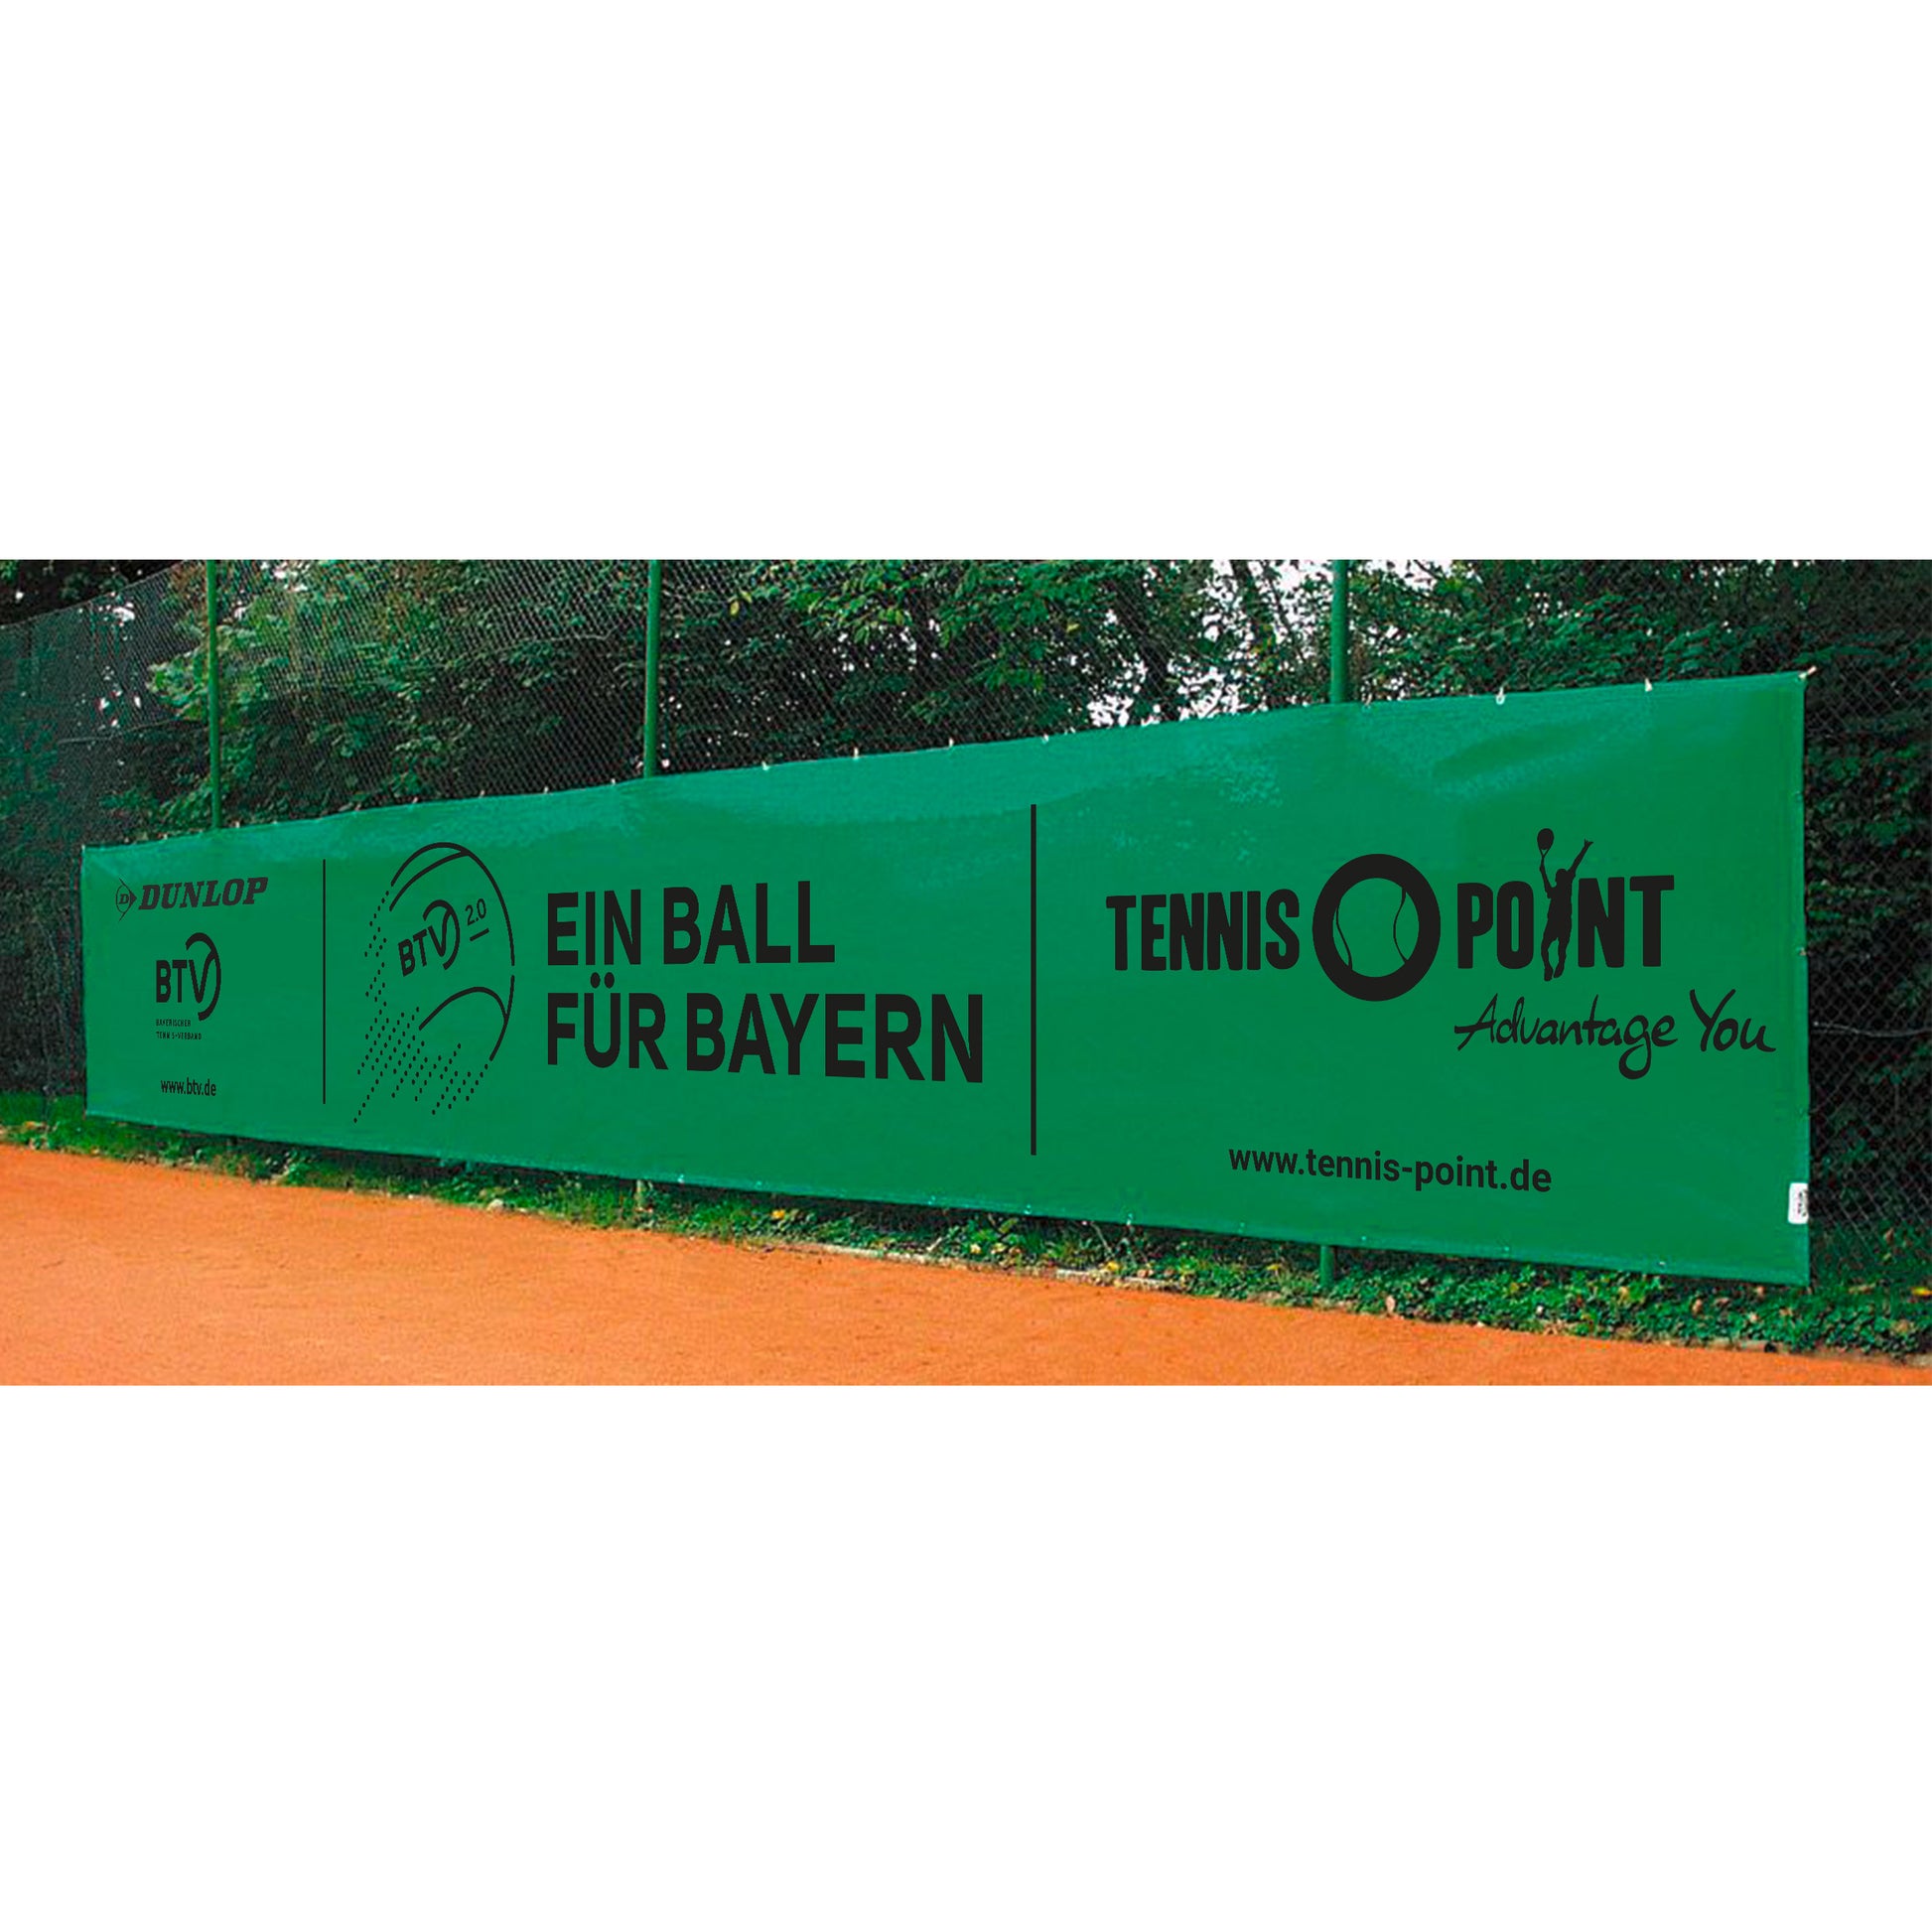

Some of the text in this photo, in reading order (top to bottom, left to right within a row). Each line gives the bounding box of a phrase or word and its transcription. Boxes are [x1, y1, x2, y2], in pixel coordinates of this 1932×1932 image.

[139, 877, 269, 910] DUNLOP
[464, 897, 488, 927] 2.0
[548, 881, 835, 966] EIN BALL
[1106, 889, 1301, 971] TENNIS
[156, 932, 221, 1021] BTV
[398, 899, 461, 977] BTV
[548, 972, 983, 1083] FÜR BAYERN
[1454, 989, 1776, 1079] Advantage You
[160, 1076, 217, 1097] www.btv.de
[1229, 1149, 1552, 1193] www.tennis-point.de
